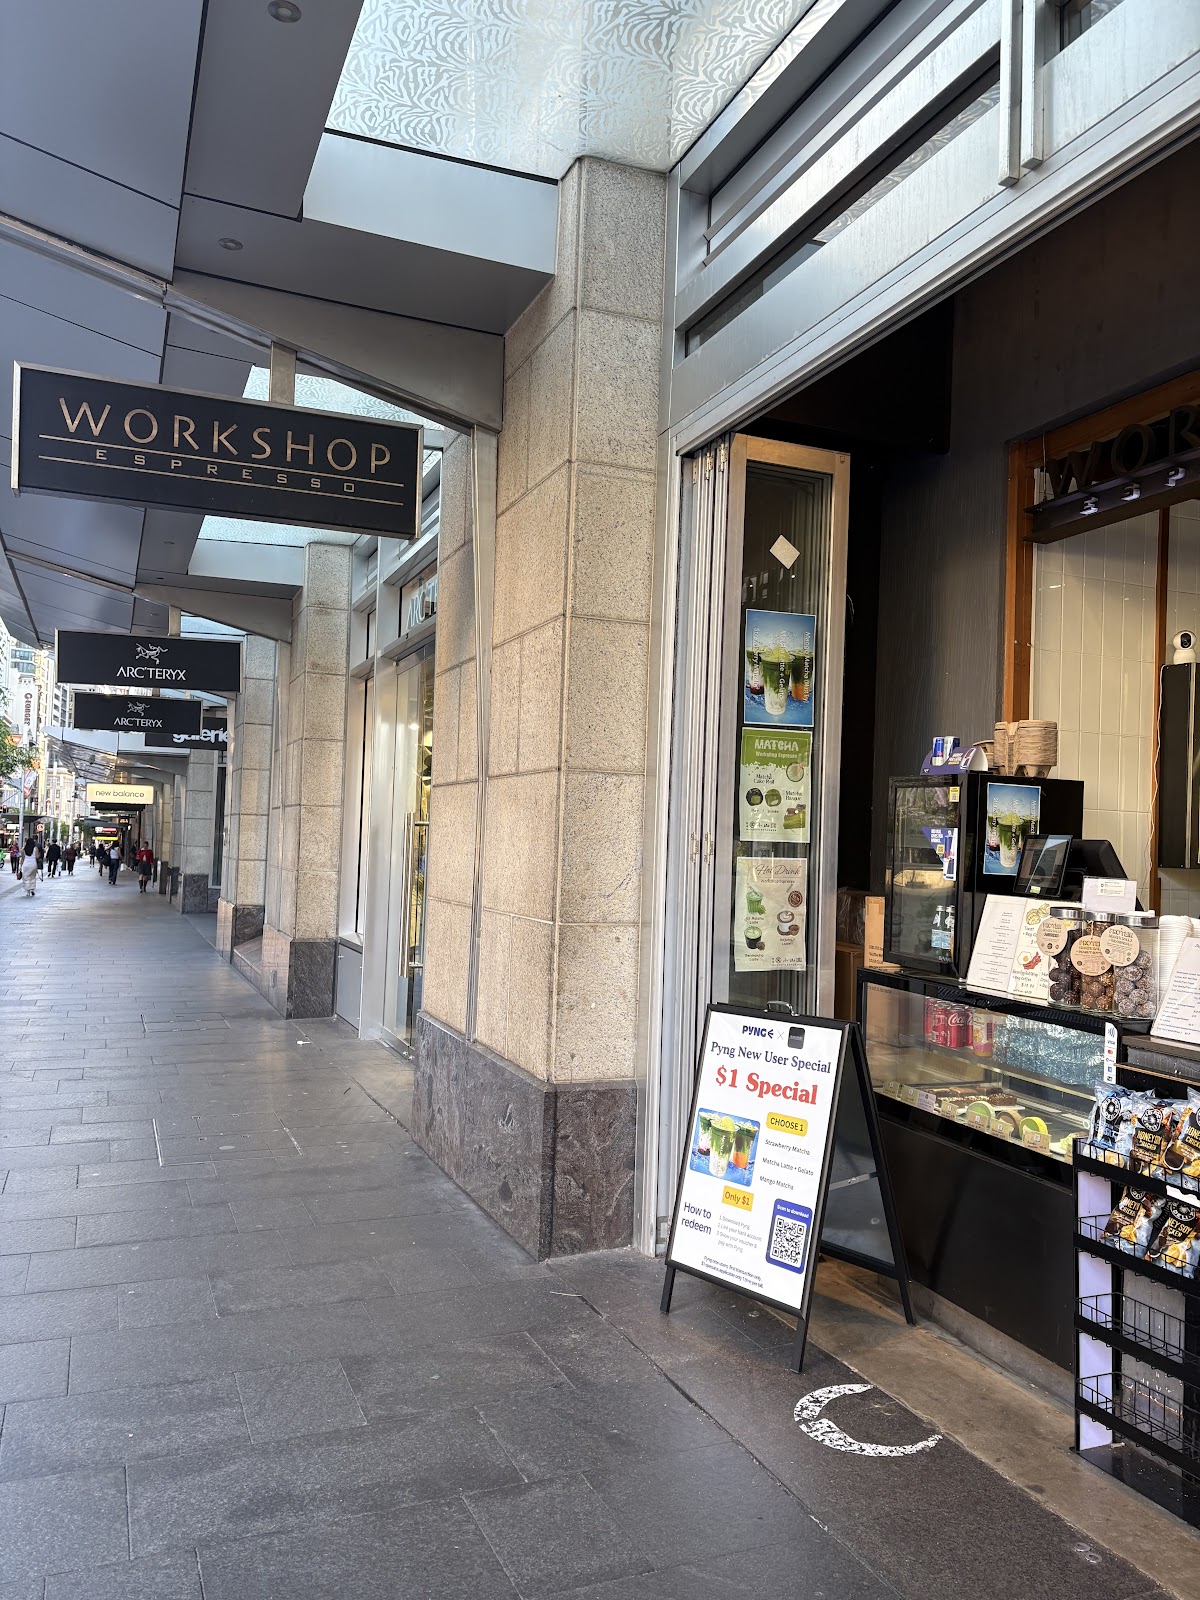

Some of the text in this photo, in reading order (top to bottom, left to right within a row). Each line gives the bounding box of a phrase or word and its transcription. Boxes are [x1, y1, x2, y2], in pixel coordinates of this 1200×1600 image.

[59, 397, 391, 474] WORKSHOP
[96, 448, 356, 493] ESPRESSO
[117, 666, 186, 680] ARC'TERYX
[114, 718, 162, 727] ARC'TERYX
[755, 739, 799, 752] MATCHA
[113, 790, 144, 798] balance
[742, 1025, 767, 1037] PYNG
[711, 1042, 831, 1073] Pyng New User Special
[716, 1065, 818, 1105] $1 Special
[770, 1118, 798, 1130] CHOOSE
[765, 1139, 810, 1155] Strawberry Matcha
[762, 1158, 779, 1166] Matcha
[781, 1162, 793, 1170] Latte
[760, 1176, 793, 1190] Mango Matcha
[725, 1191, 750, 1205] Only $1
[684, 1202, 712, 1219] How to
[681, 1217, 712, 1234] redeem
